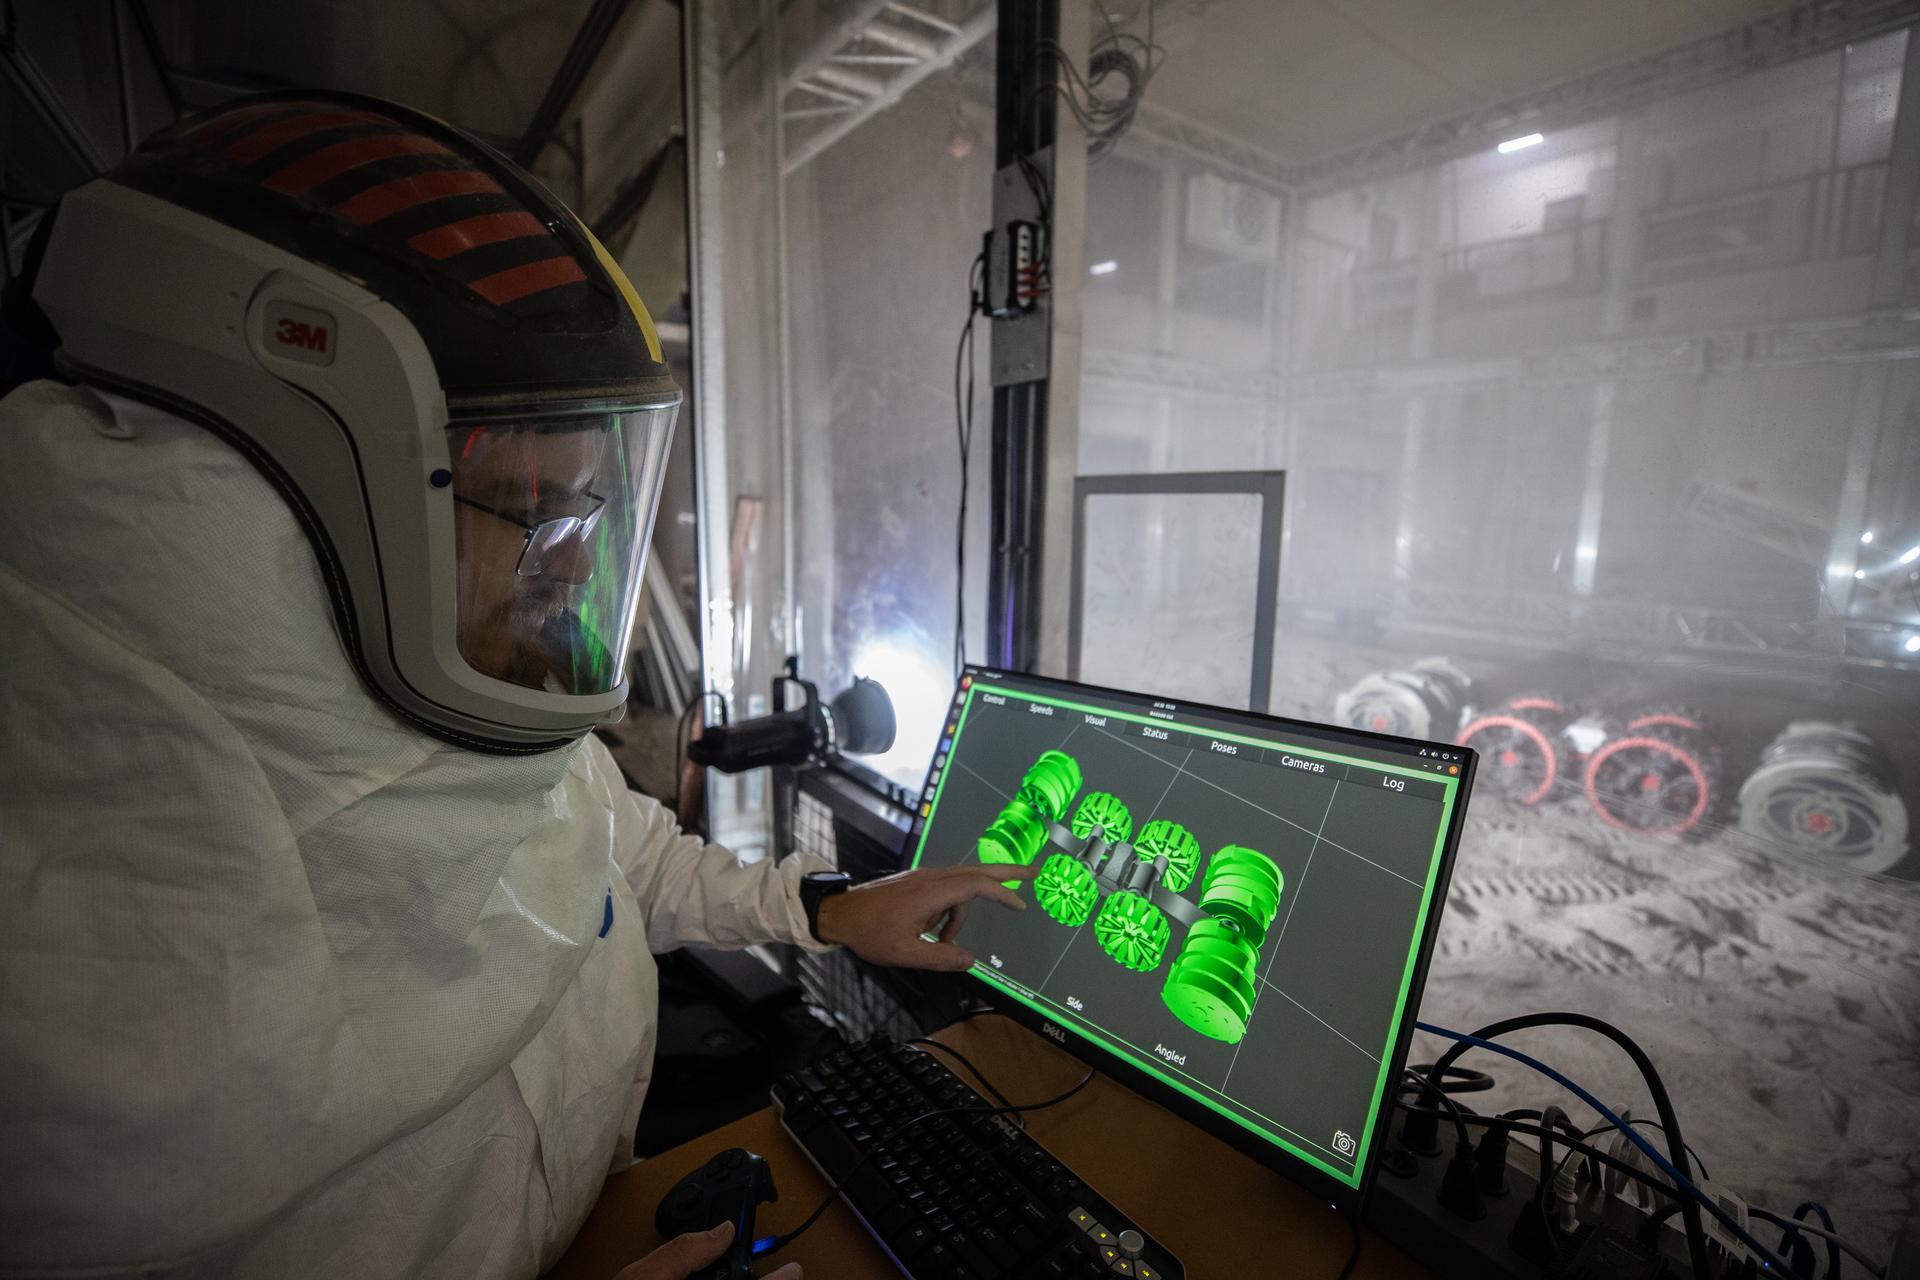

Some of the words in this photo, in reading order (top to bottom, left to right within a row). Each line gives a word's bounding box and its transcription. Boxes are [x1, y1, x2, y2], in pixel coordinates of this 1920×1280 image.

[275, 318, 328, 353] 3M
[983, 693, 1006, 706] Control
[1029, 703, 1054, 716] Speeds
[1084, 714, 1107, 728] Visual
[1142, 727, 1168, 740] Status
[1211, 740, 1238, 756] Poses
[1281, 755, 1326, 774] Cameras
[1383, 776, 1406, 792] Log
[990, 954, 1004, 969] Top
[1066, 996, 1083, 1011] Side
[1043, 1022, 1065, 1043] DELL
[1154, 1043, 1186, 1066] Angled
